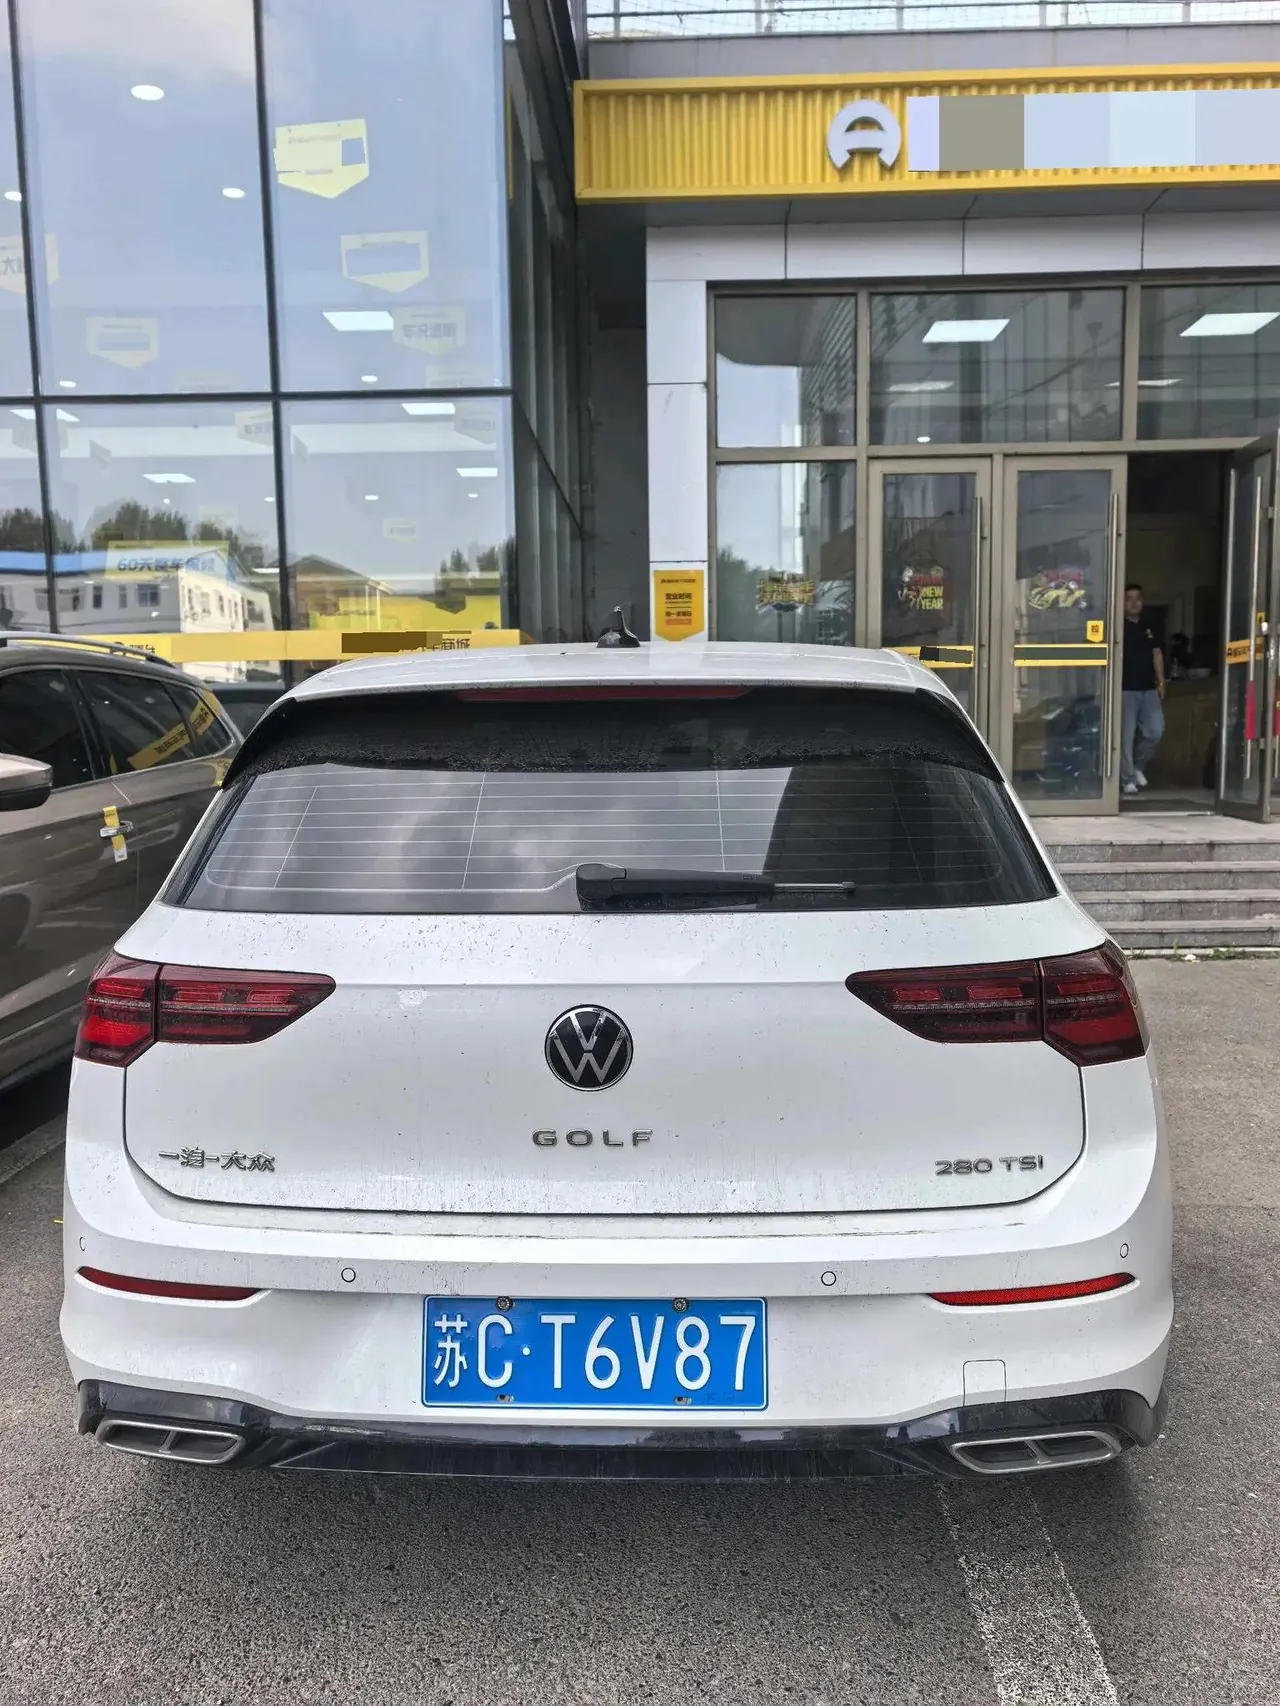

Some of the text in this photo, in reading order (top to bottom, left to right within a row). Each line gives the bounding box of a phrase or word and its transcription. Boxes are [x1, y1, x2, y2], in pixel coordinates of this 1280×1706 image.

[919, 585, 944, 597] NEW
[920, 598, 944, 610] YEAR
[532, 1128, 653, 1147] GOLF
[935, 1155, 1043, 1176] 280 TSI
